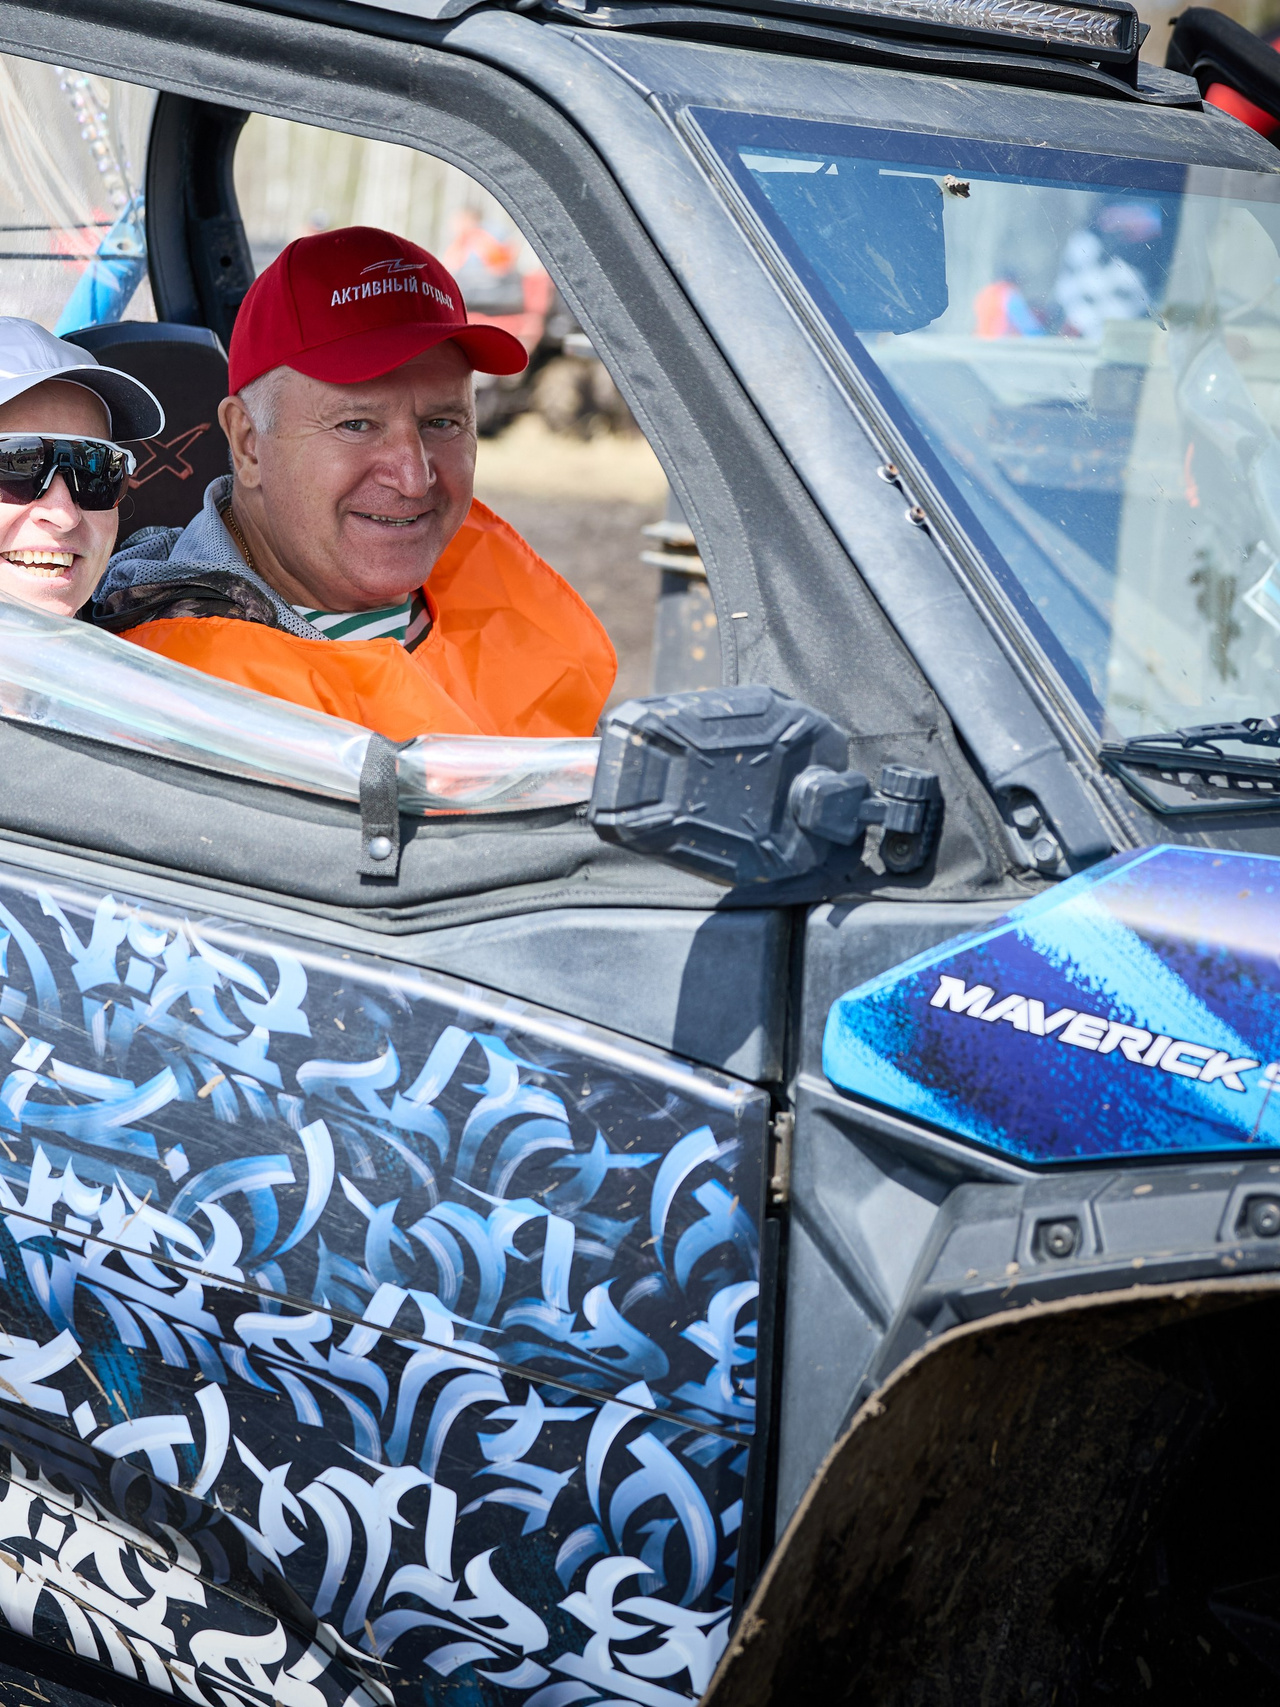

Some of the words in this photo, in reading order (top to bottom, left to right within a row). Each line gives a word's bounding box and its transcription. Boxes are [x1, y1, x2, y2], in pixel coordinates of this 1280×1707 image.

[331, 275, 418, 307] АКТИВНЫЙ
[421, 281, 455, 311] ОТДЫХ
[929, 974, 1261, 1093] MAVERICK
